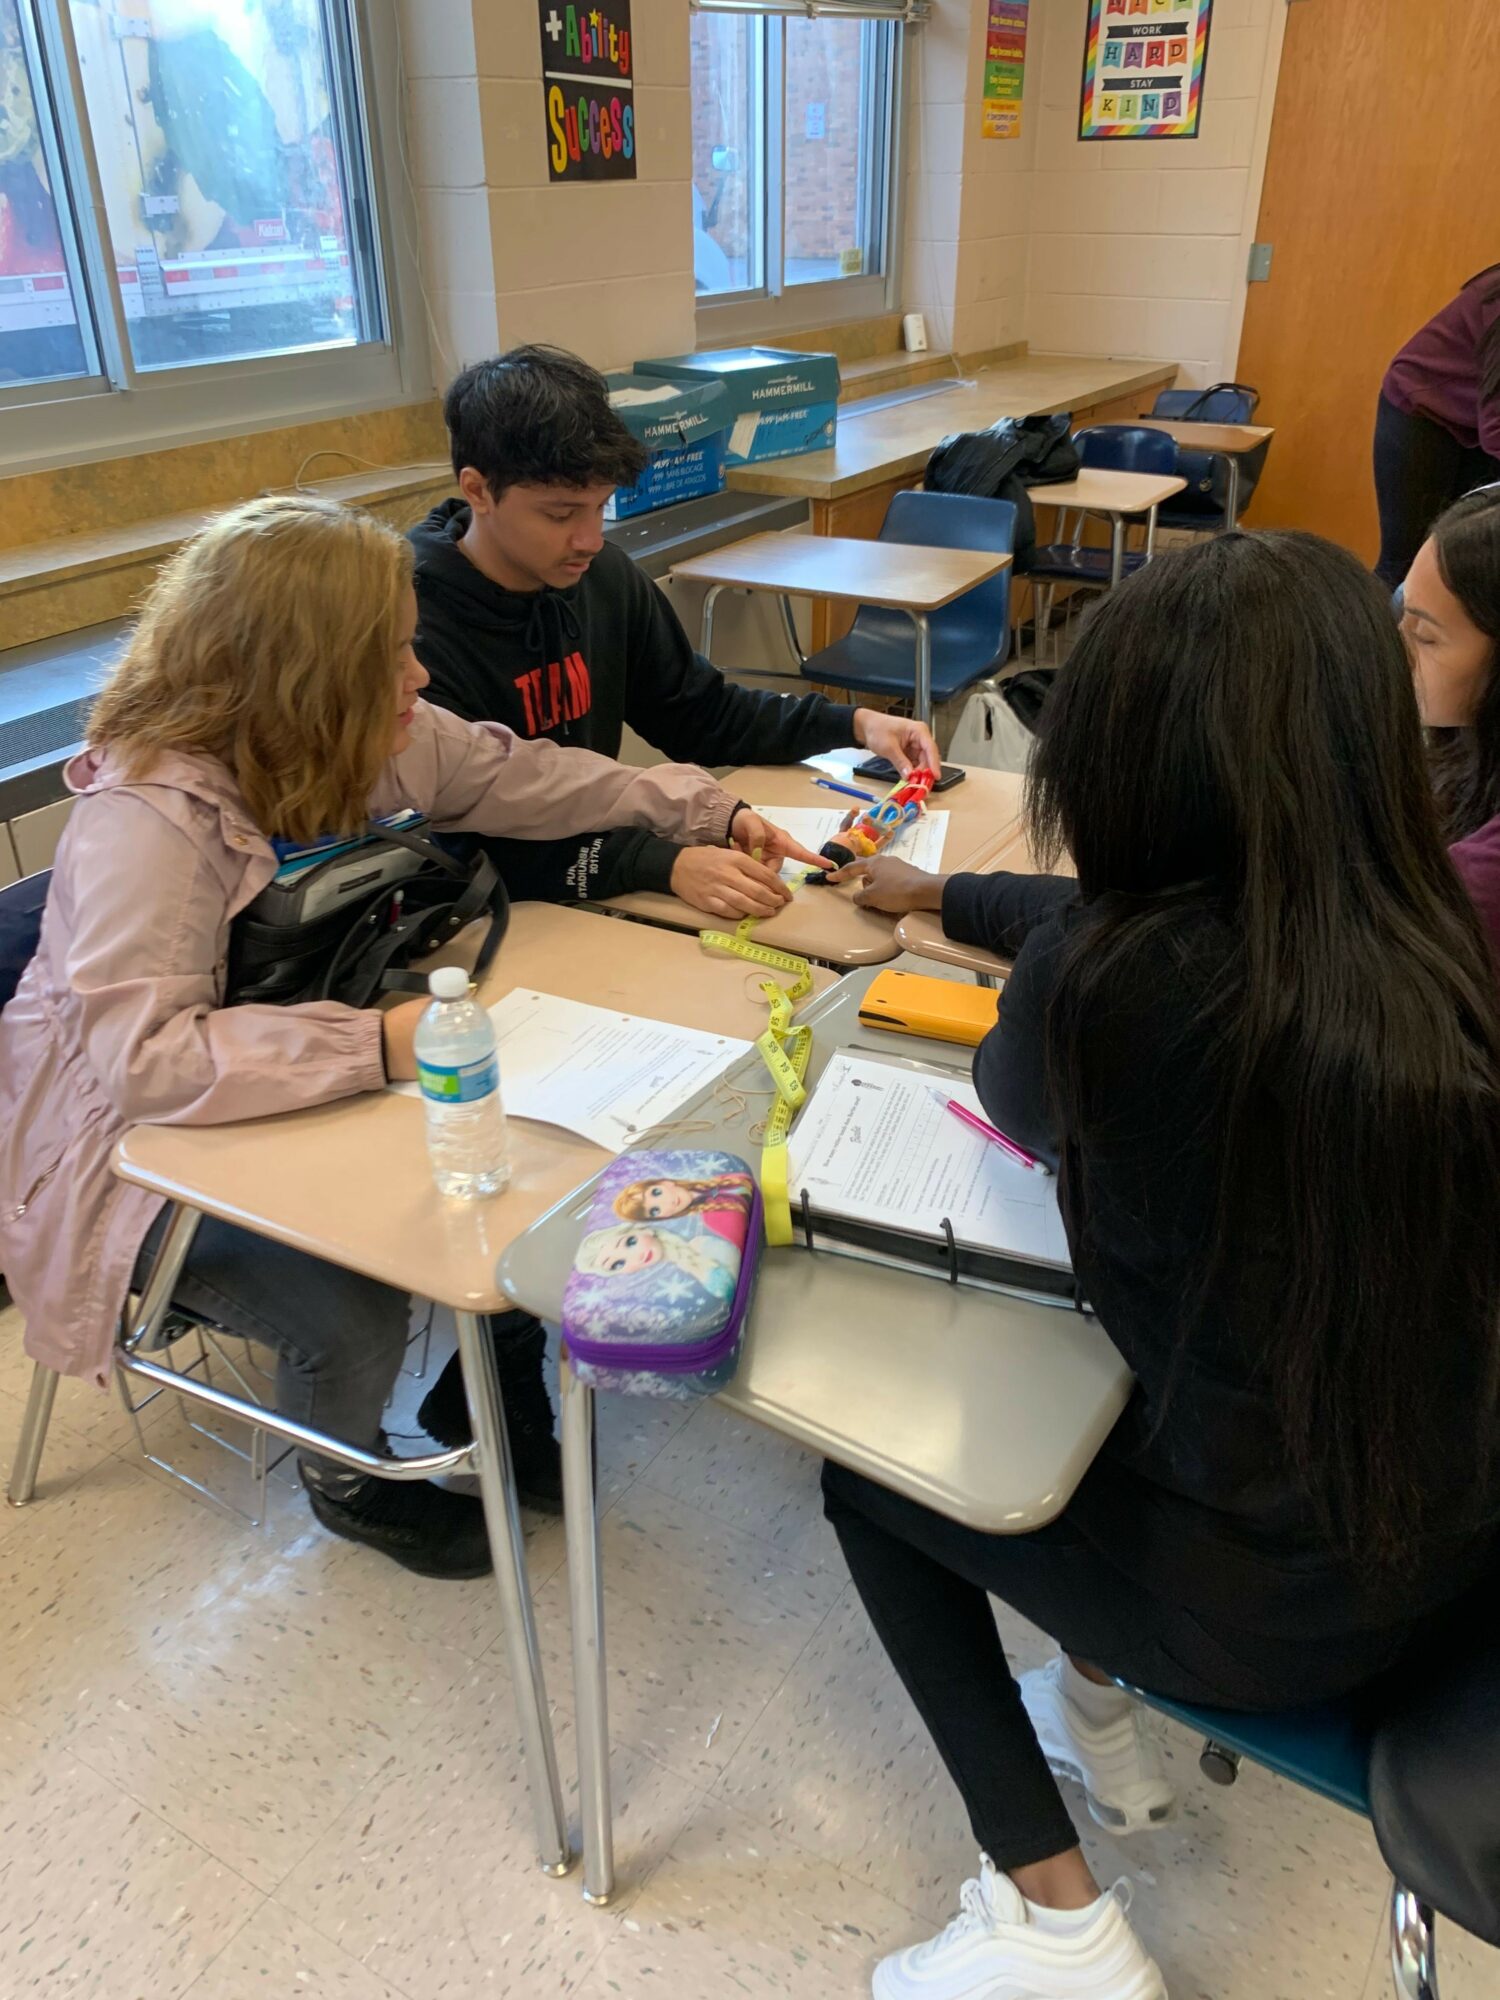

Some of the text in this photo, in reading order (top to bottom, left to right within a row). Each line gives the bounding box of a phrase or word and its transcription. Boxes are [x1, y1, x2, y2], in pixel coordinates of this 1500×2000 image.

[1132, 25, 1162, 35] WORK
[1106, 44, 1184, 61] HARD
[1130, 79, 1154, 88] STAY
[1102, 95, 1177, 112] KIND
[549, 85, 633, 173] Success
[752, 381, 816, 400] HAMMERMILL
[644, 413, 709, 438] HAMMERMILL
[792, 983, 802, 993] 50
